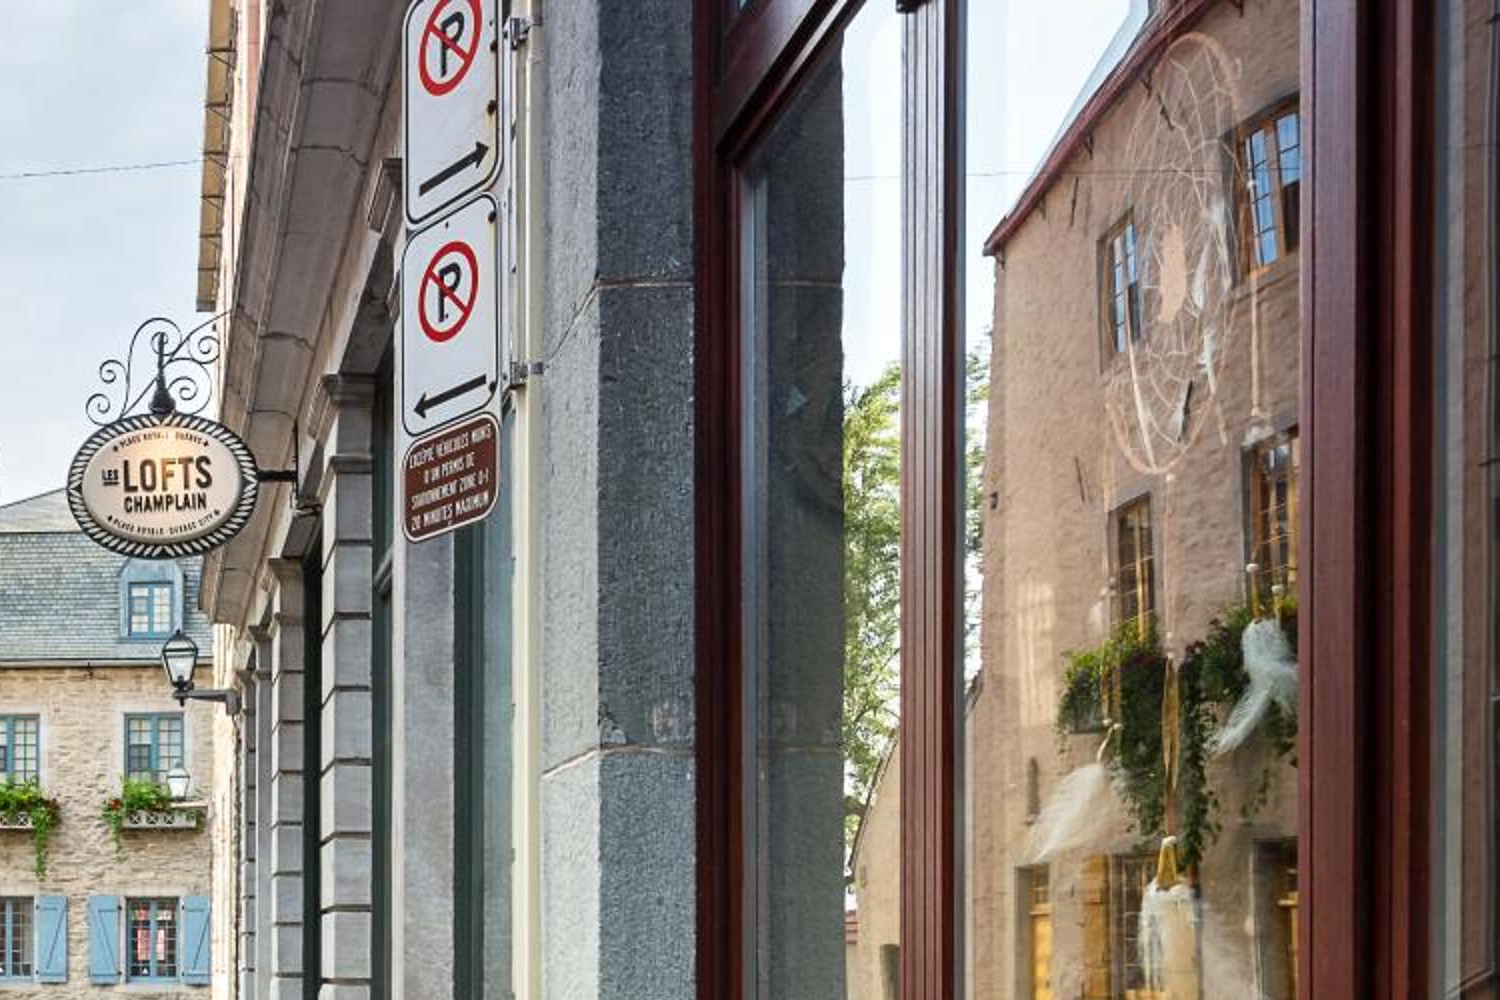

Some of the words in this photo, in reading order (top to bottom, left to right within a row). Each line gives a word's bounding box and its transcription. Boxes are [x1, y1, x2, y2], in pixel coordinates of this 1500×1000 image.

[465, 451, 475, 467] DE
[101, 469, 119, 481] LES
[123, 455, 213, 493] LOFTS
[459, 472, 477, 493] ZONE
[124, 492, 207, 513] CHAMPLAIN
[423, 503, 453, 527] MINUTES
[455, 491, 489, 516] MAXIMUM
